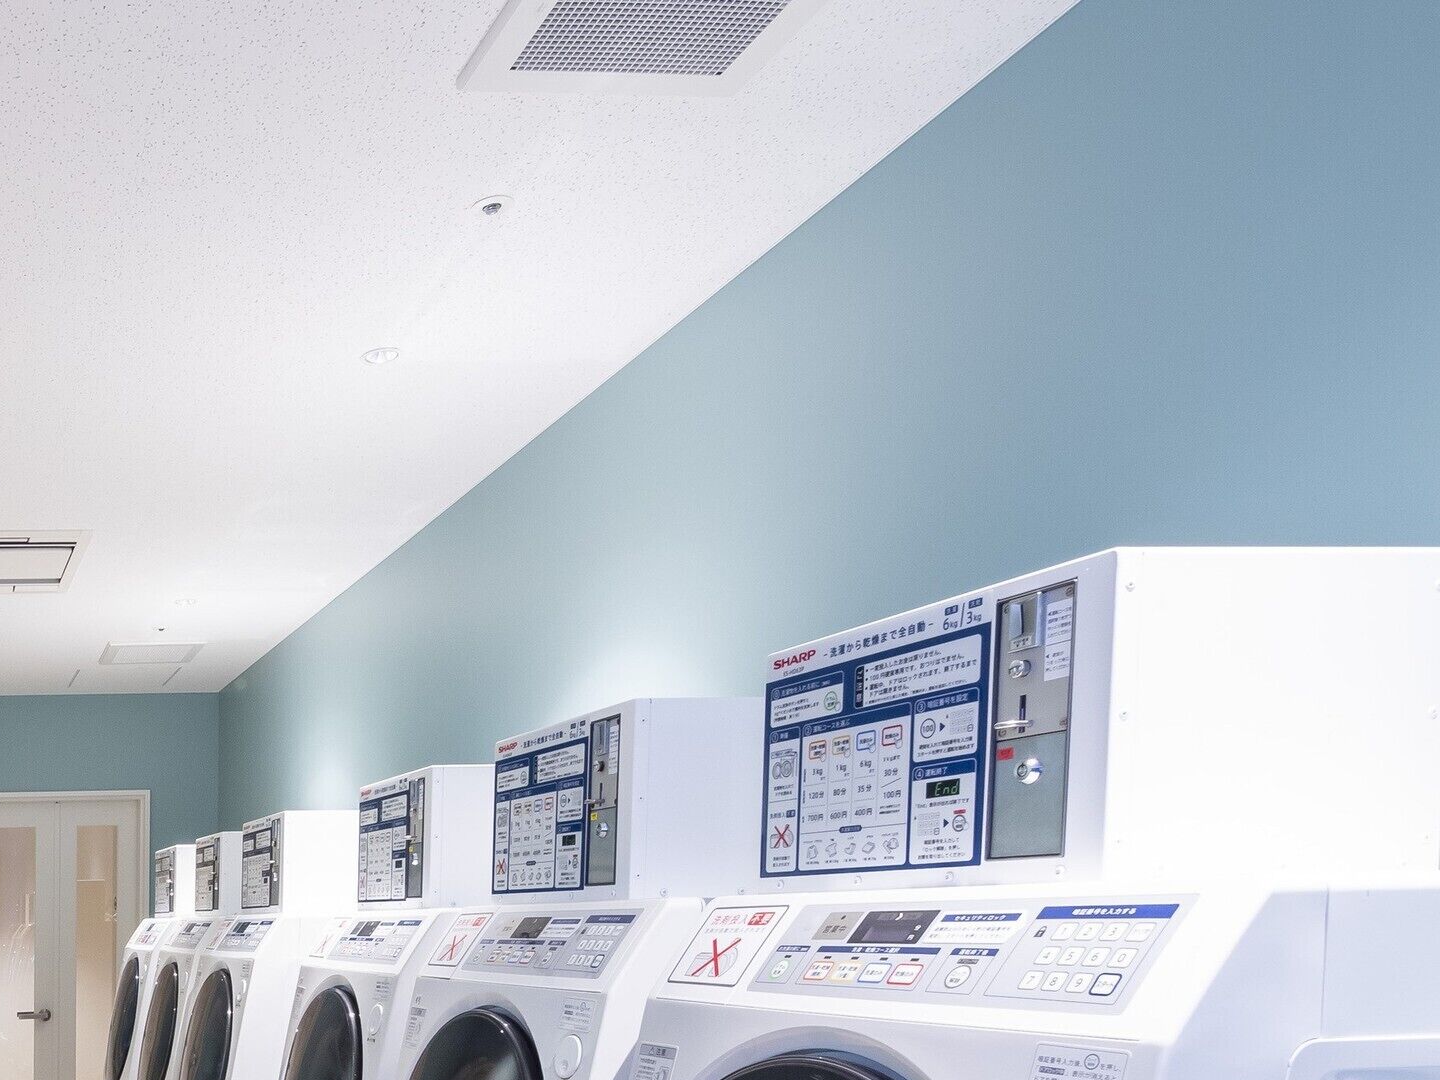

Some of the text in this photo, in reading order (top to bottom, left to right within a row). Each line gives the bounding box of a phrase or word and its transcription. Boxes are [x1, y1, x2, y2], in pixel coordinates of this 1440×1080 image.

[773, 649, 817, 670] SHARP
[934, 781, 959, 796] End
[1083, 927, 1093, 936] 2
[1109, 927, 1118, 937] 3
[1065, 951, 1074, 961] 5
[1091, 952, 1099, 962] 6
[1118, 953, 1127, 963] 0
[1027, 975, 1083, 987] 7 8 9
